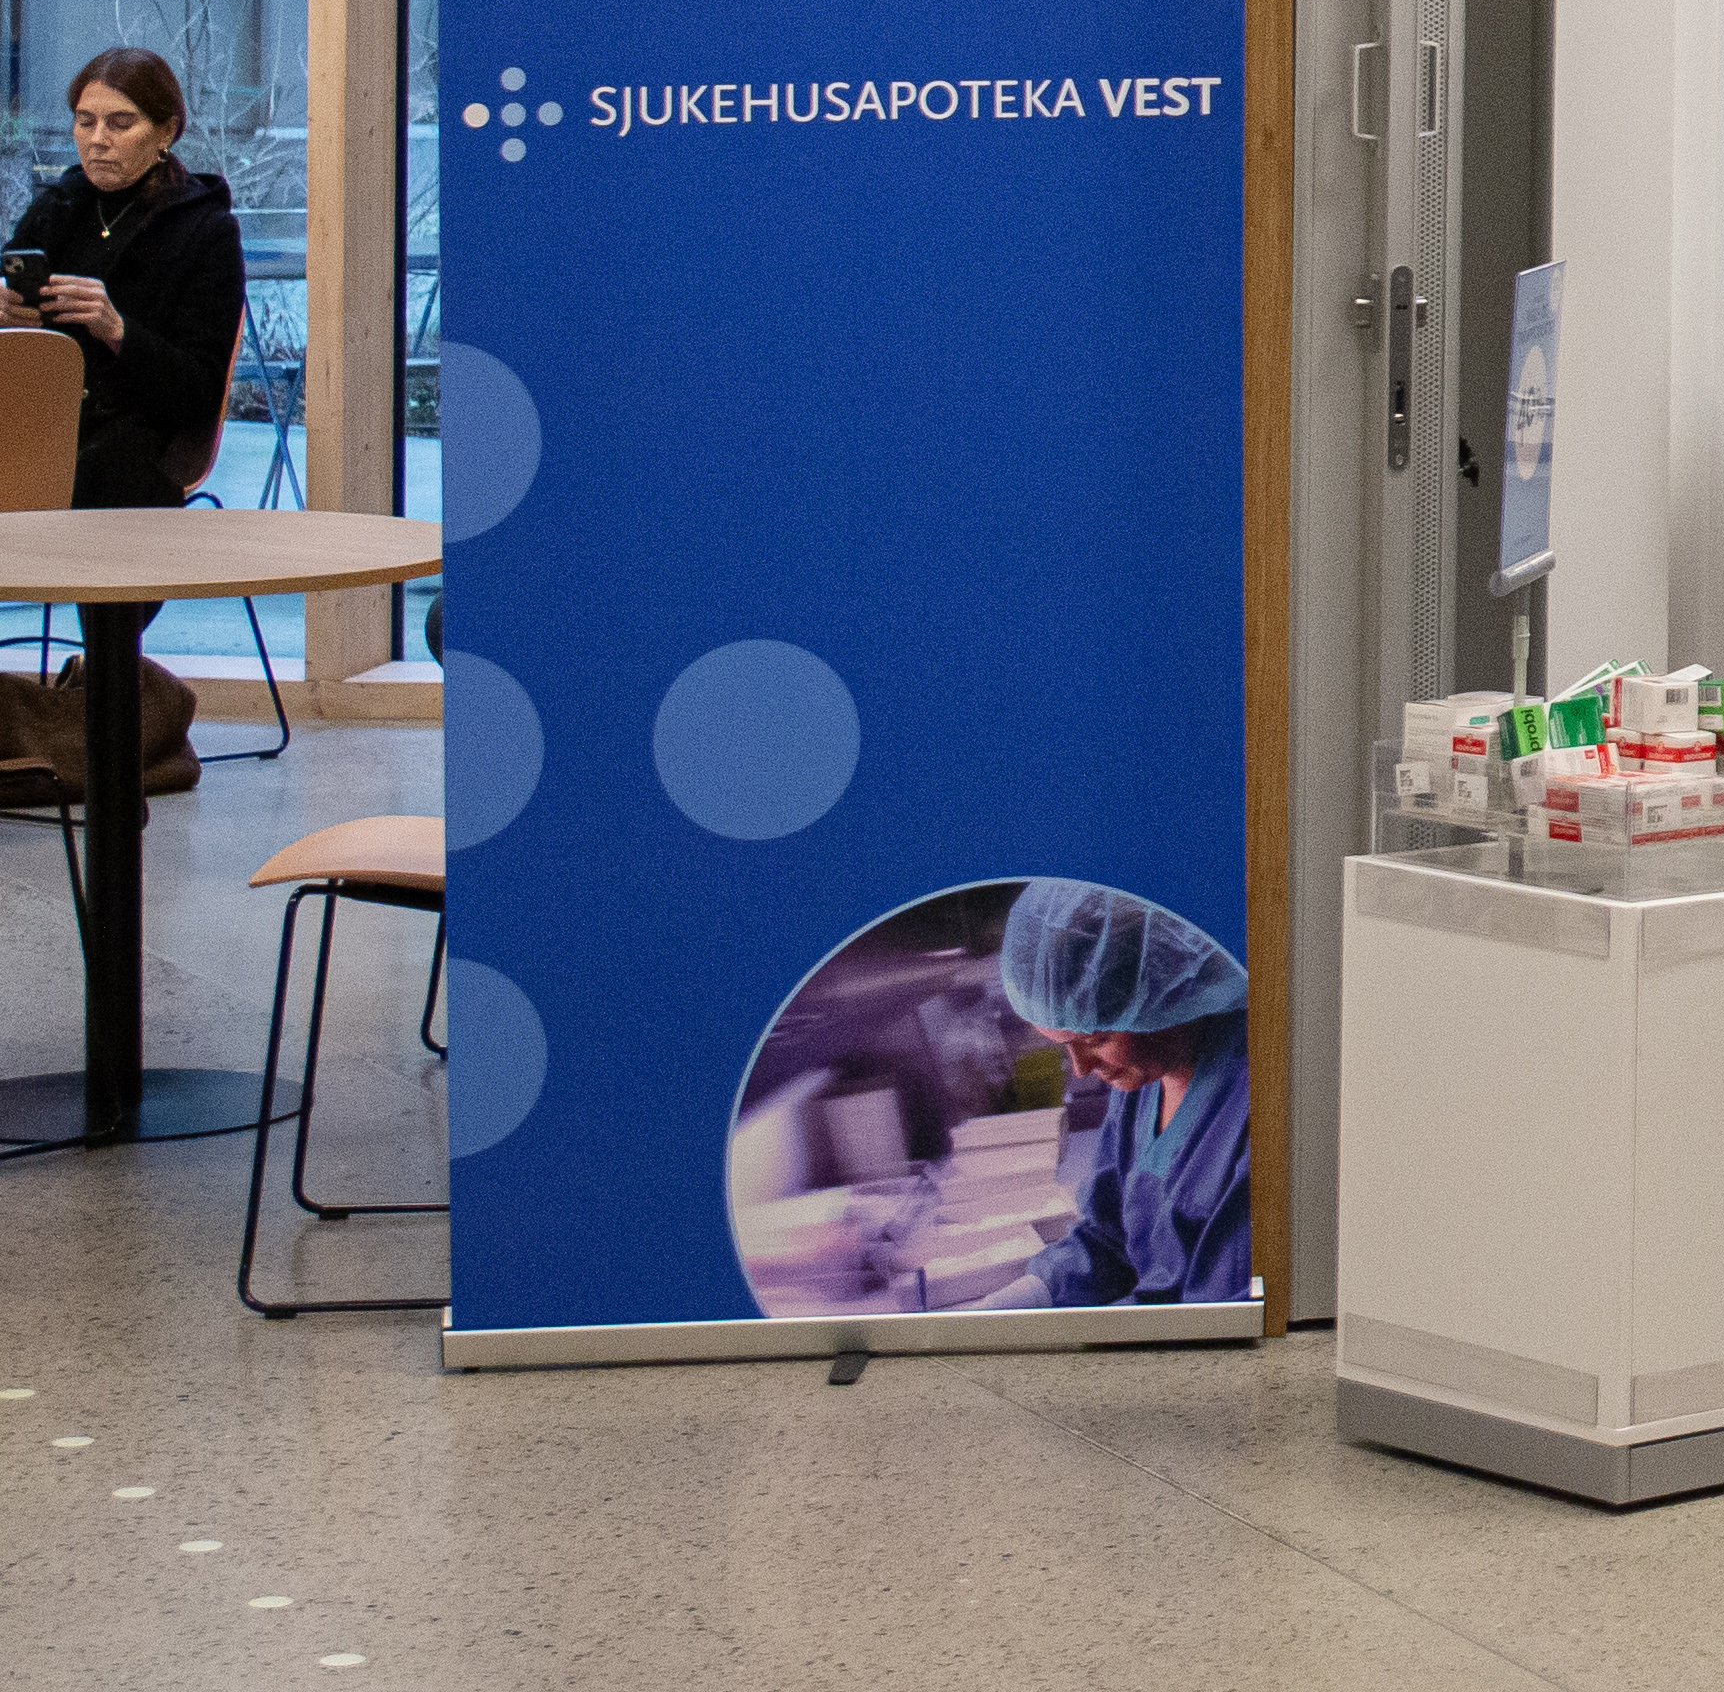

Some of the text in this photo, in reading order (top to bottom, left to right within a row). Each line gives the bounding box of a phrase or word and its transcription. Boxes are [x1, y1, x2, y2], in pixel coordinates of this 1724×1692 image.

[589, 76, 1222, 137] SJUKEHUSAPOTEKA VEST
[1521, 708, 1543, 752] probi
